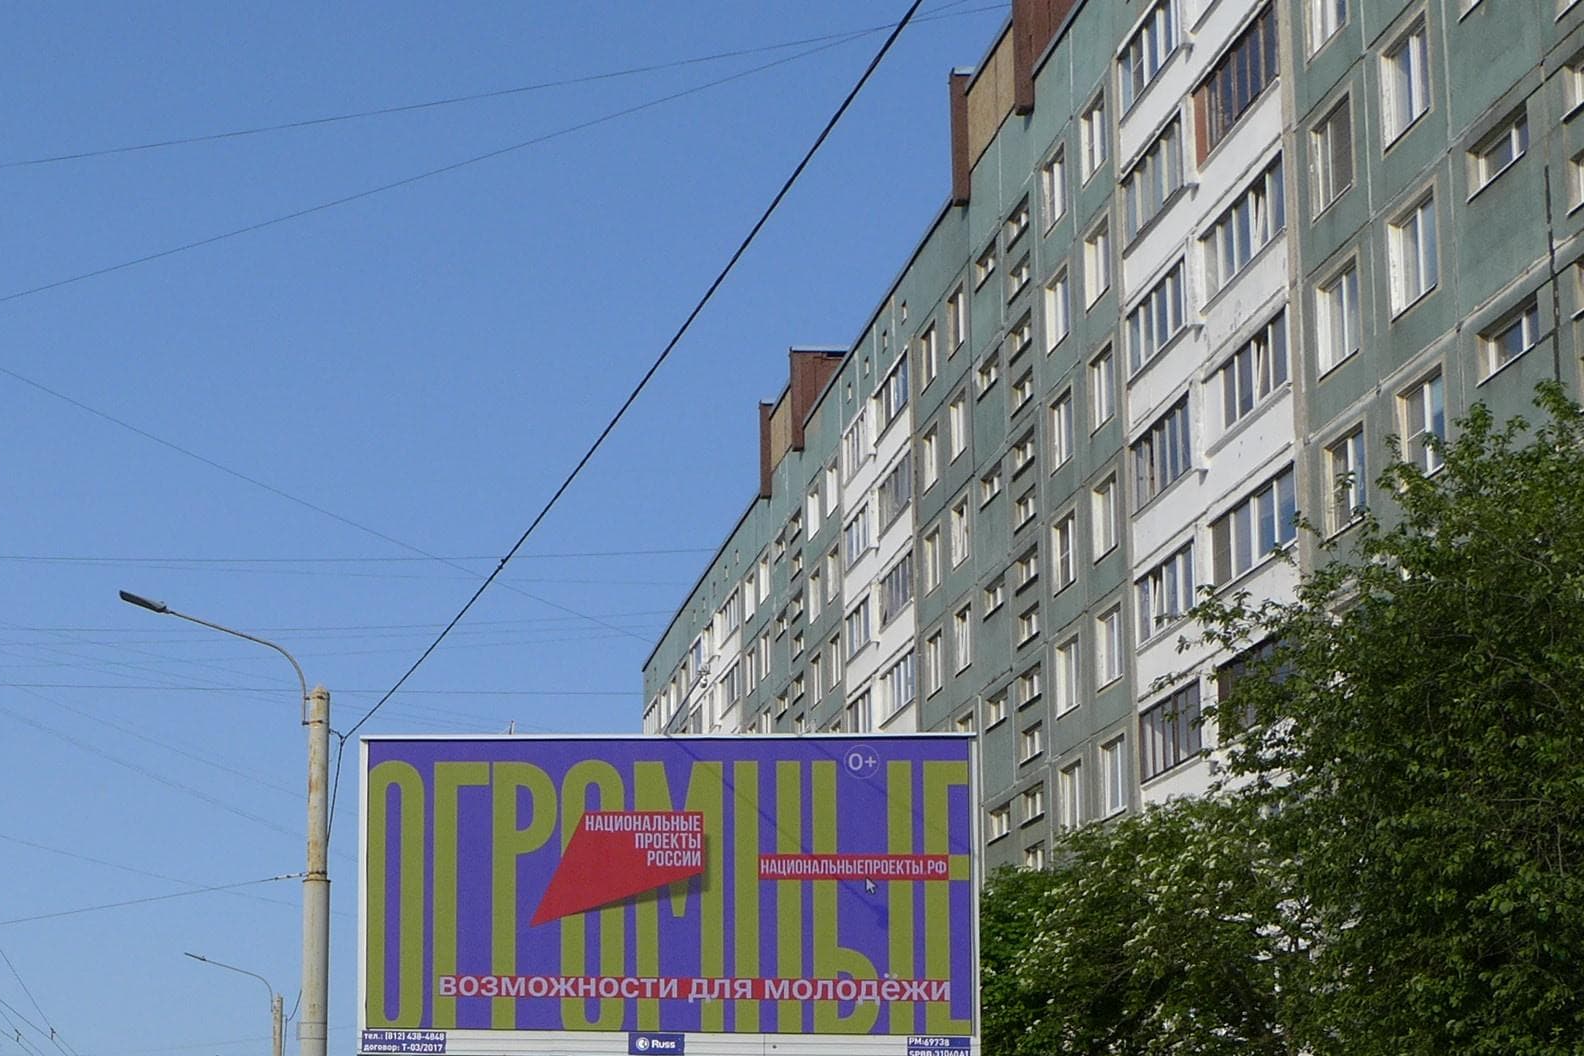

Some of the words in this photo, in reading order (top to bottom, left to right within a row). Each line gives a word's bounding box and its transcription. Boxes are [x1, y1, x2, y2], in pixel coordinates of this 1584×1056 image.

[848, 753, 876, 771] 0+
[584, 815, 702, 832] НАЦИОНАЛЬНЫЕ
[634, 832, 702, 849] ПРОЕКТЫ
[646, 850, 702, 867] РОССИИ
[759, 858, 948, 877] НАЦИОНАЛЬНЫЕПРОЕКТЫ.РФ
[438, 975, 679, 999] возможности
[688, 977, 753, 1004] для
[763, 972, 952, 1007] молодёжи
[651, 1039, 676, 1049] Russ
